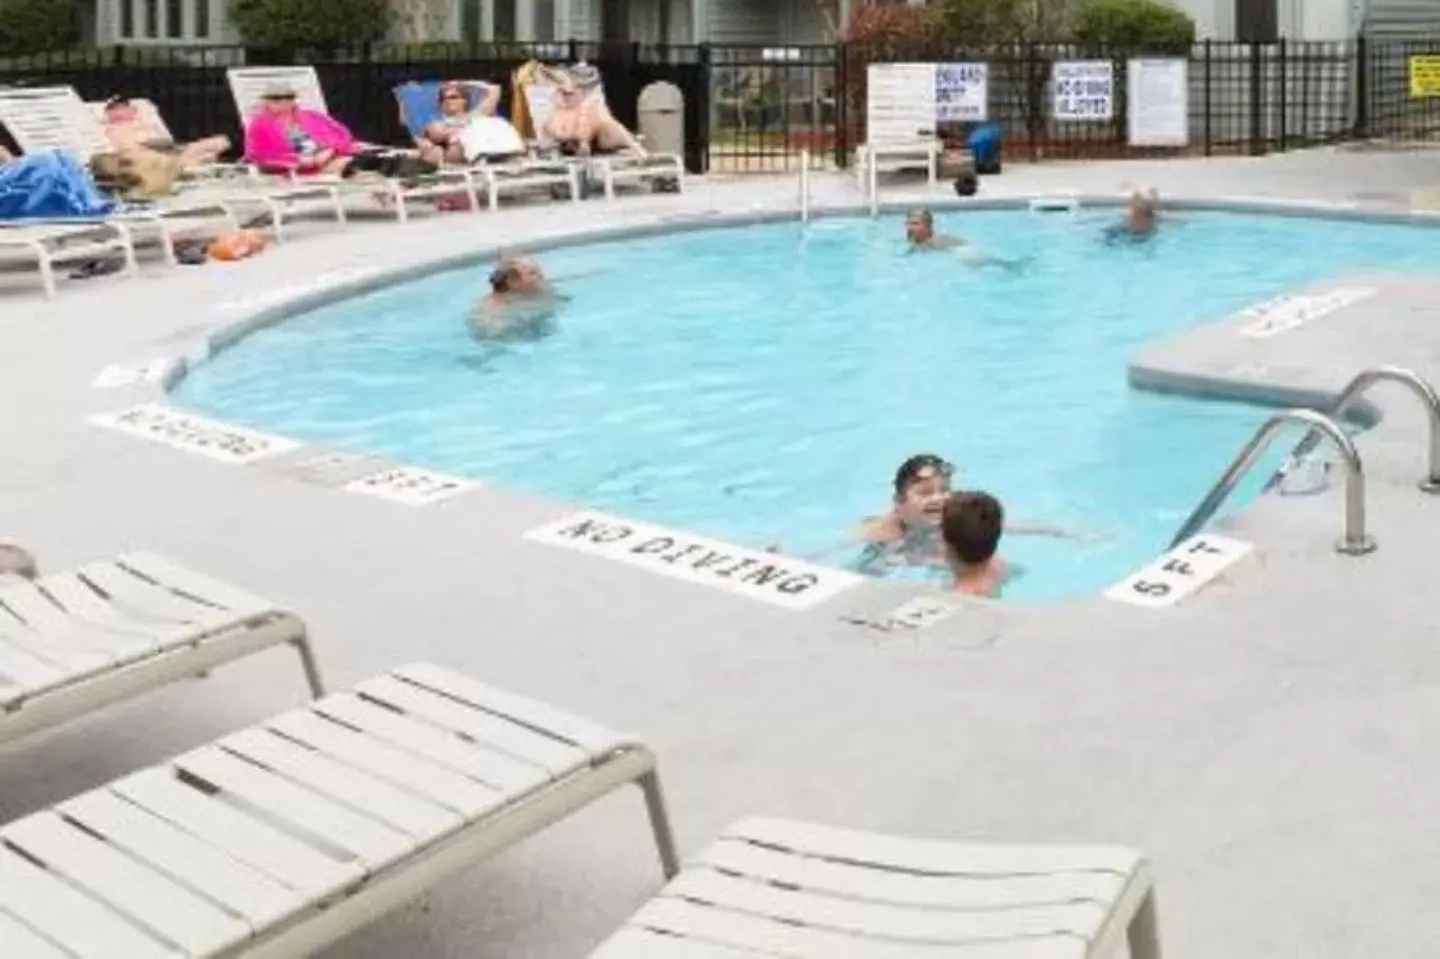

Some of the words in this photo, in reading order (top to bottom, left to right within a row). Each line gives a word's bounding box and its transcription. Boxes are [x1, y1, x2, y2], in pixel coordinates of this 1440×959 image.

[558, 519, 635, 542] NO
[631, 537, 818, 594] DIVING
[1133, 580, 1170, 596] 5
